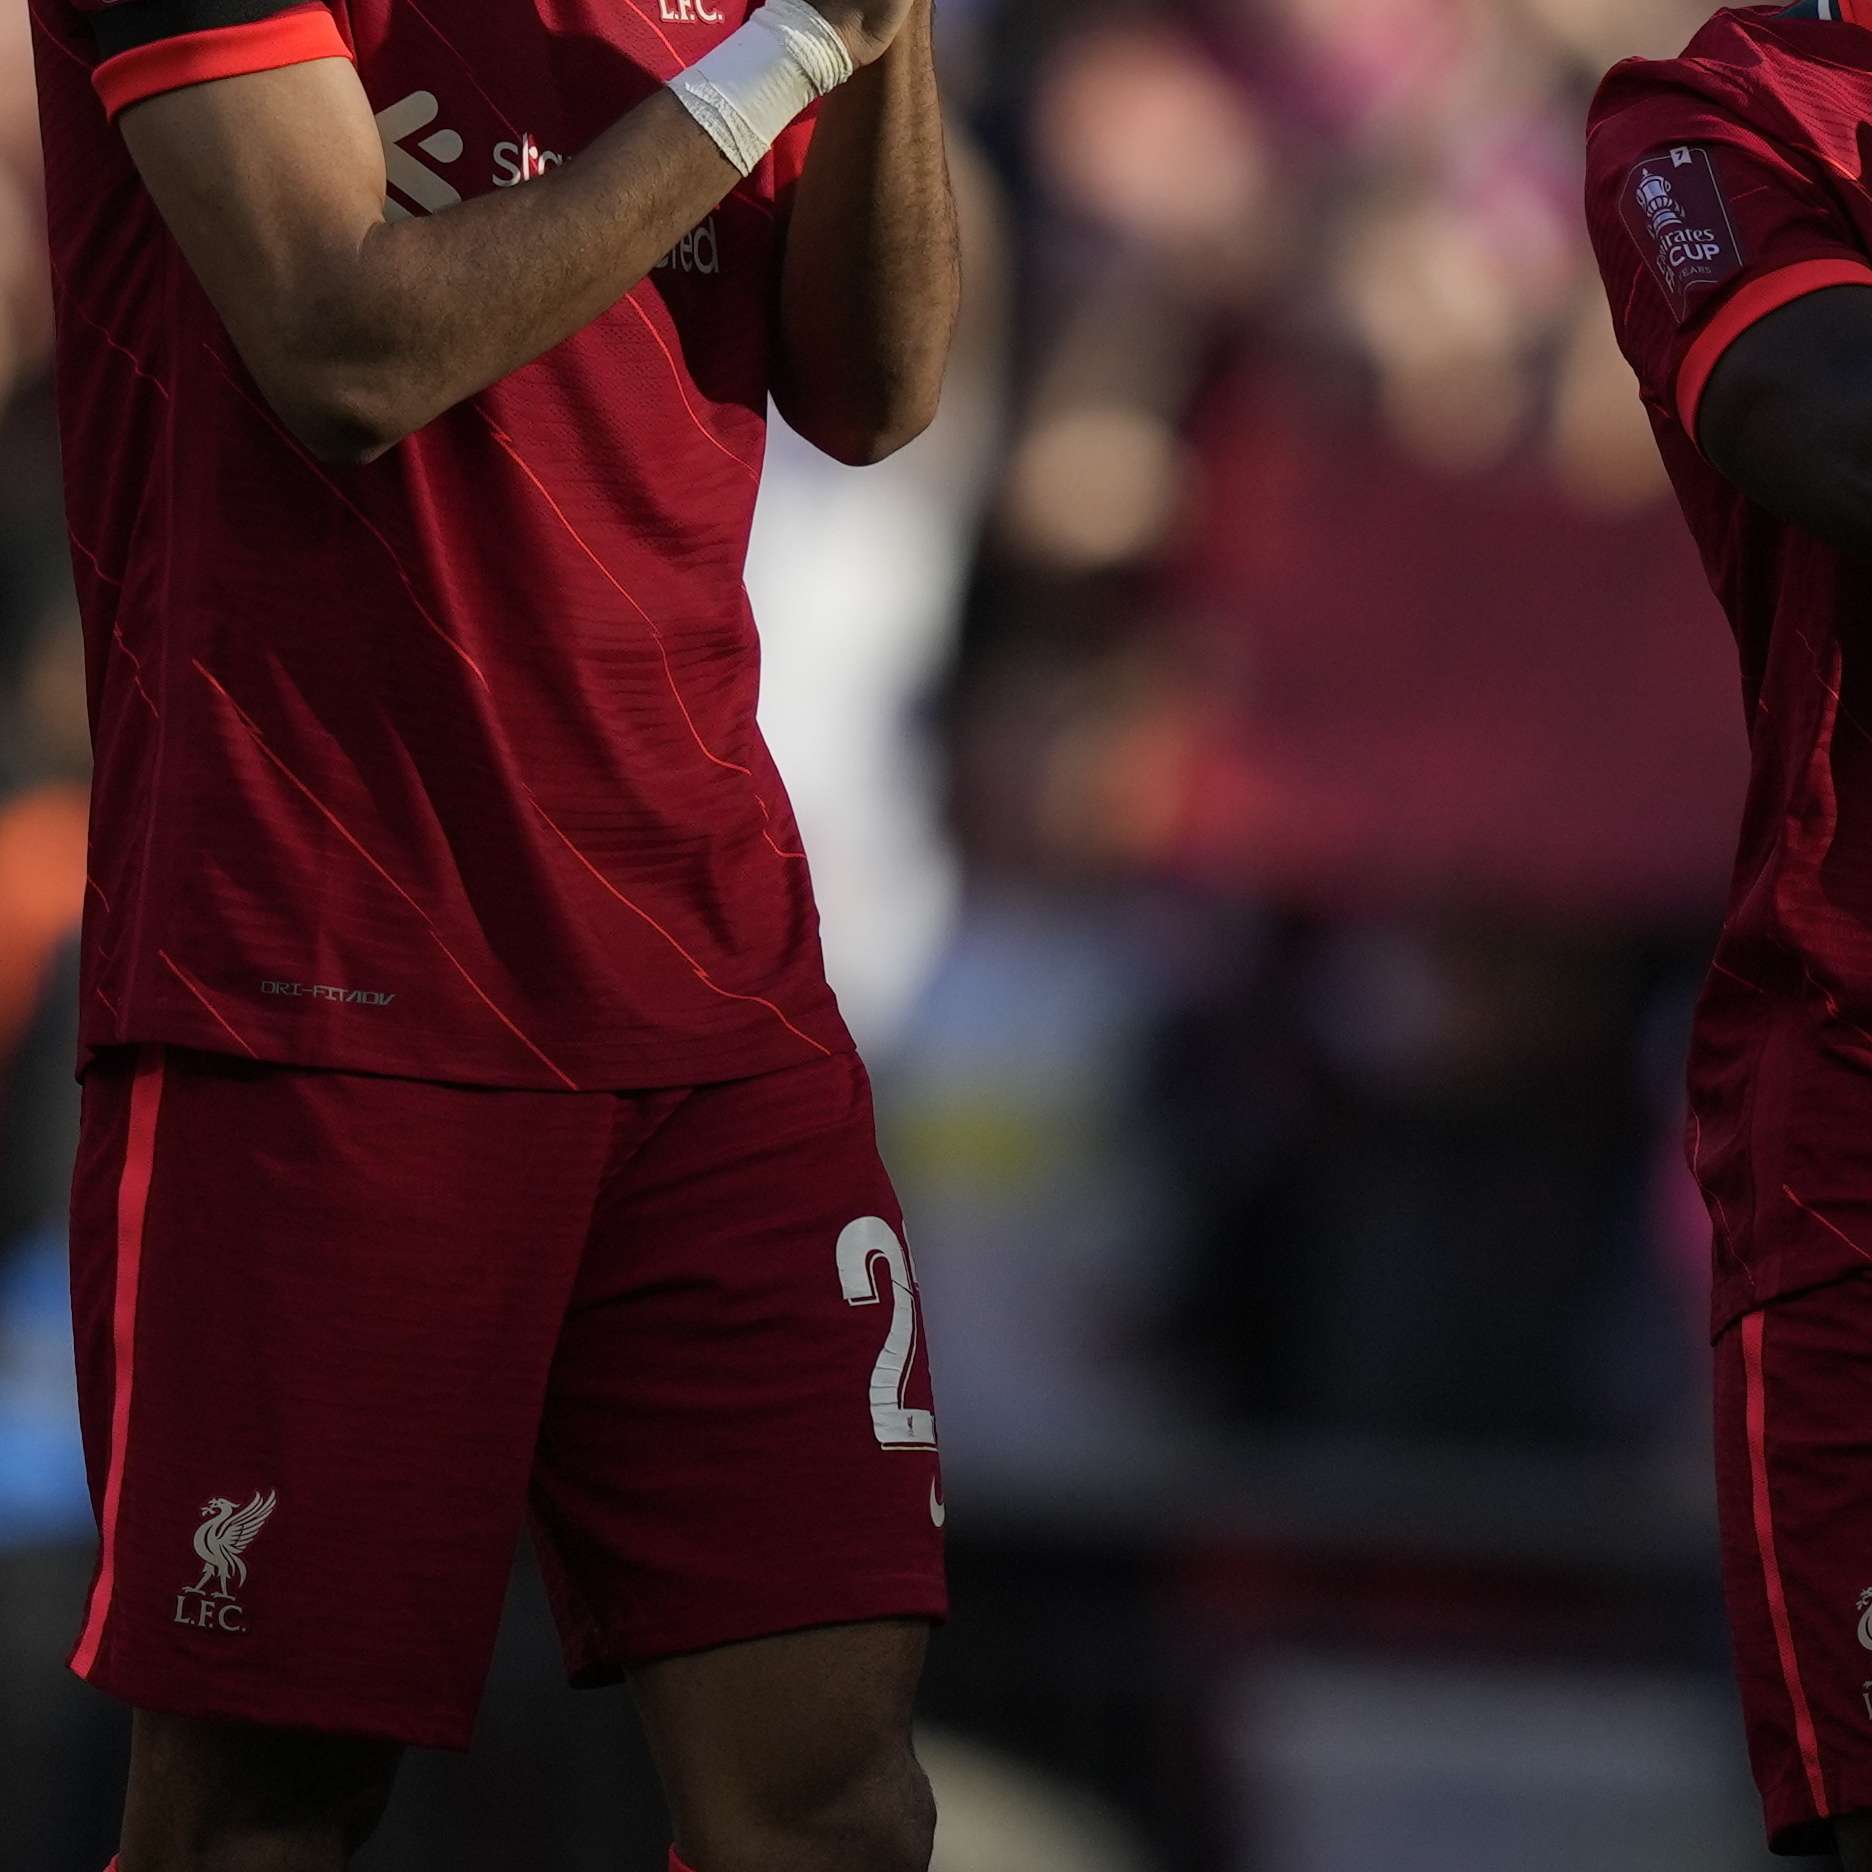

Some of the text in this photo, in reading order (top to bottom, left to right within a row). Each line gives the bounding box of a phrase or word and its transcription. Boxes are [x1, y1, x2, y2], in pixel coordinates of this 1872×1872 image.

[1669, 243, 1721, 267] CUP
[834, 1215, 938, 1452] 2
[174, 1594, 247, 1632] L.F.C.
